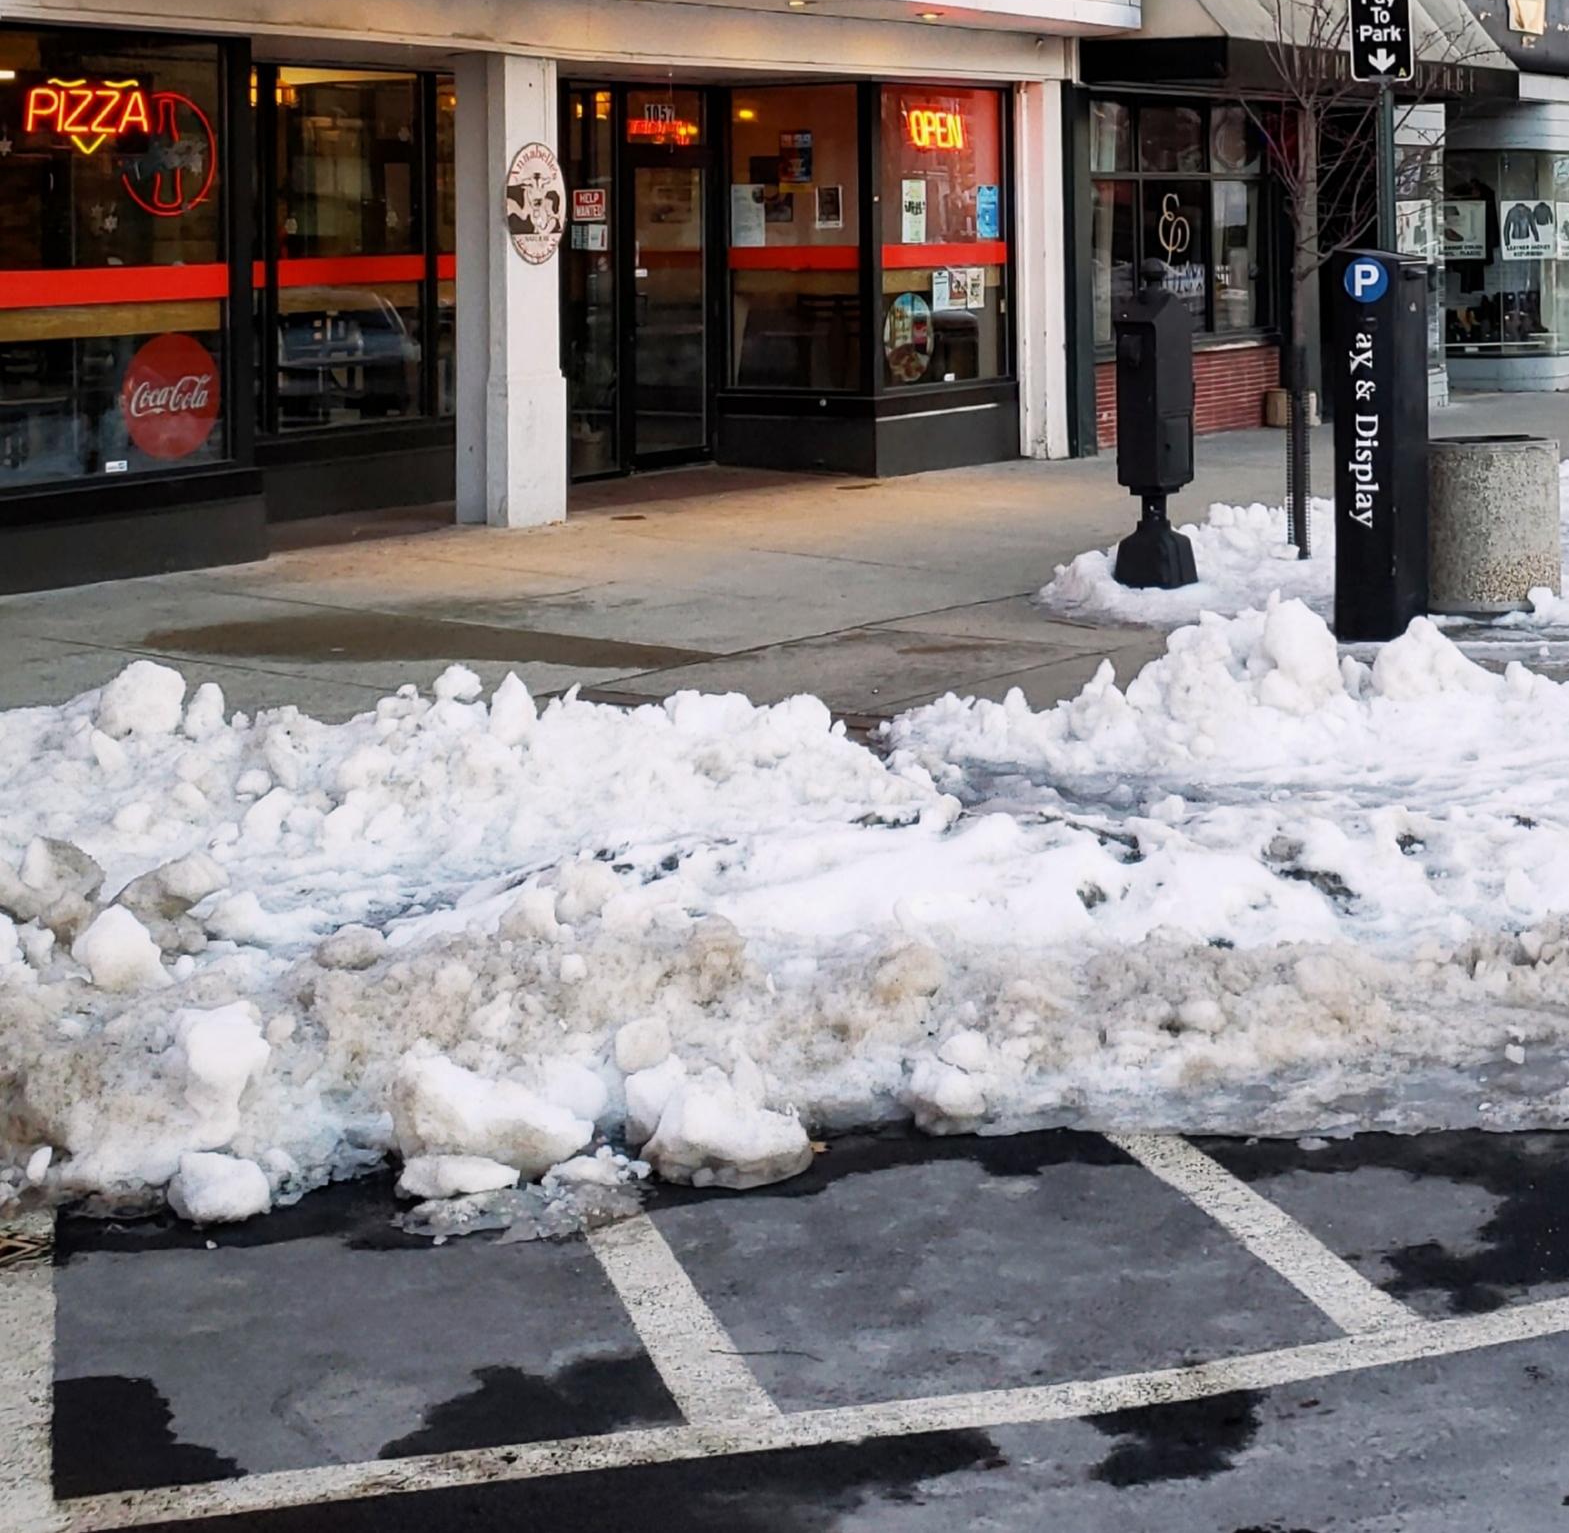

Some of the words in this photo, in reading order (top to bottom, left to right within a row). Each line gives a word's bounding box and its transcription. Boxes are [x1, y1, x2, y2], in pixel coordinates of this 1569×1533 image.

[1370, 6, 1390, 24] To
[1360, 25, 1402, 42] Park
[26, 87, 149, 134] PIZZA
[646, 105, 673, 122] 1057
[909, 109, 964, 149] OPEN
[579, 192, 601, 204] HELP
[1354, 264, 1379, 297] P
[130, 373, 212, 418] Coca-Cola
[1355, 380, 1377, 401] &
[1349, 414, 1379, 529] Display
